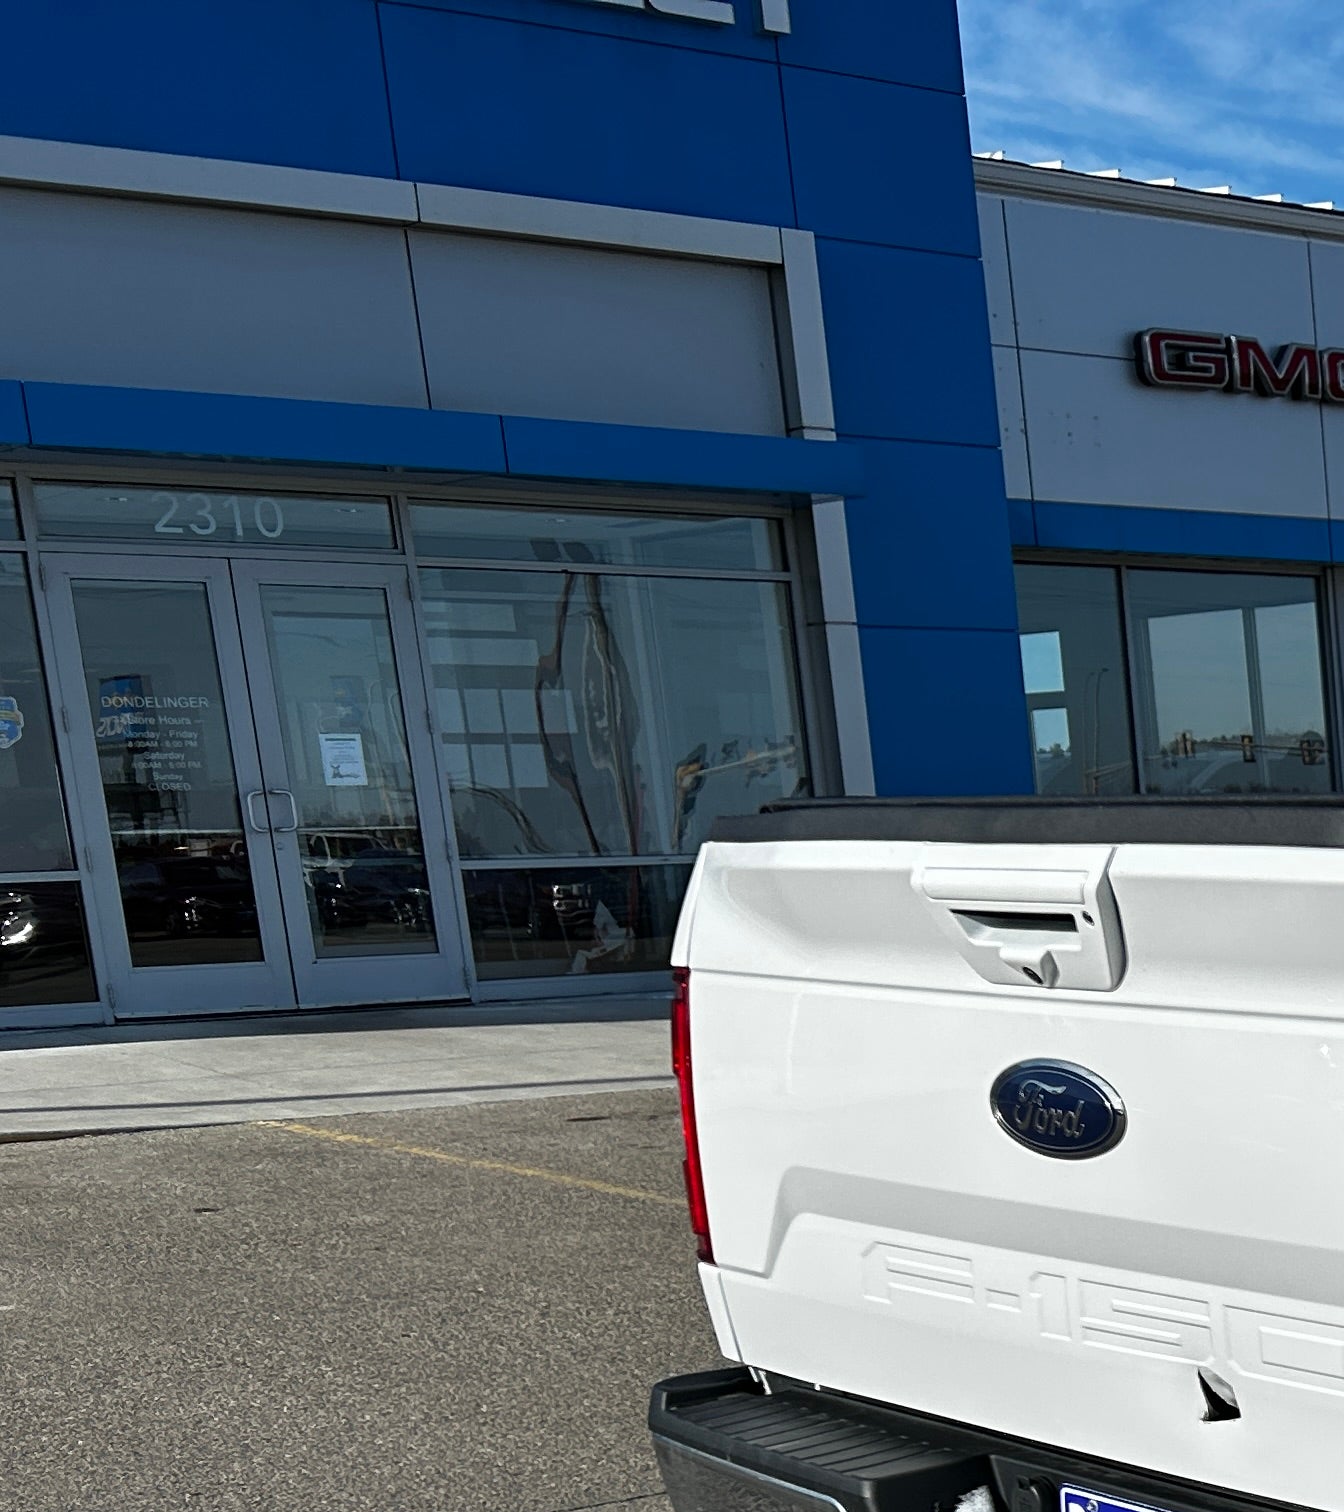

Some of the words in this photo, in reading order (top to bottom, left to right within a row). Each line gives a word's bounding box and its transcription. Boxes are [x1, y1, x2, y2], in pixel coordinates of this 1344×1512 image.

[150, 491, 284, 539] 2310
[101, 696, 209, 709] DONDELINGER
[158, 714, 192, 726] Hours
[168, 729, 198, 740] Friday
[143, 751, 185, 761] Saturday
[152, 771, 183, 781] Sunday
[148, 782, 192, 791] CLOSED
[1013, 1079, 1086, 1139] Ford
